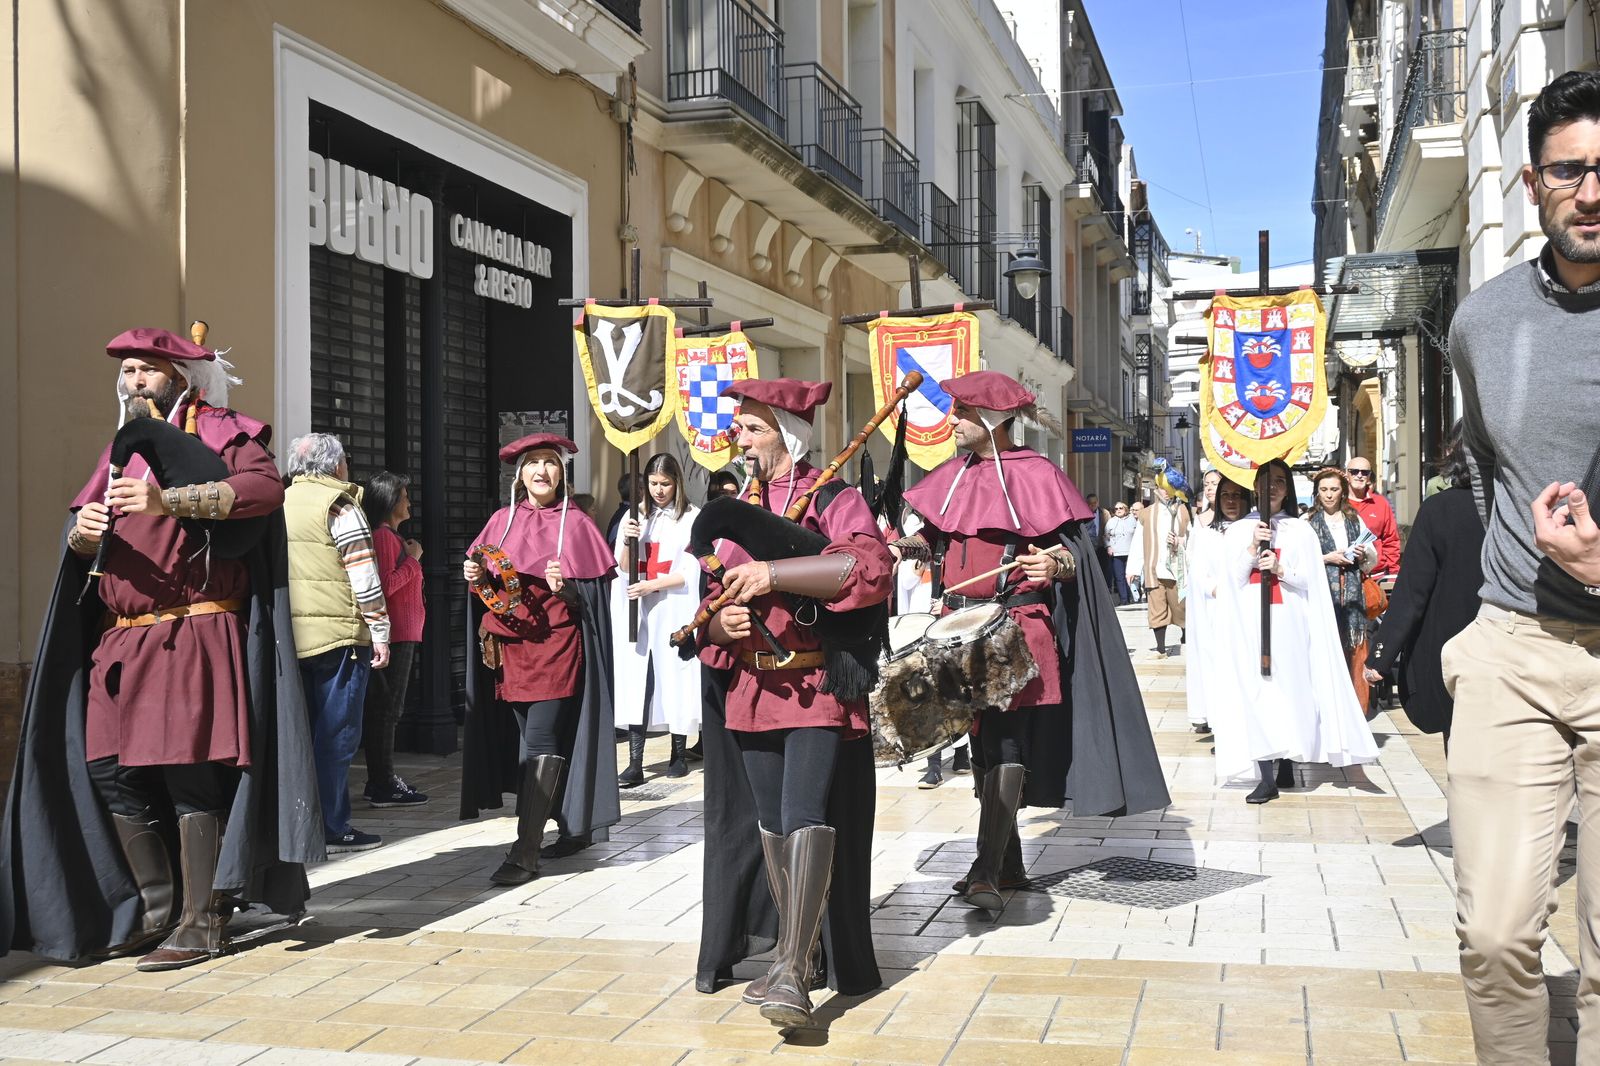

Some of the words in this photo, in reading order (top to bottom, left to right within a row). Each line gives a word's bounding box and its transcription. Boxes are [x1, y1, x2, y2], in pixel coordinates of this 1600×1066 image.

[309, 150, 433, 279] BURRO
[450, 213, 524, 268] CANAGLIA
[523, 240, 552, 278] BAR
